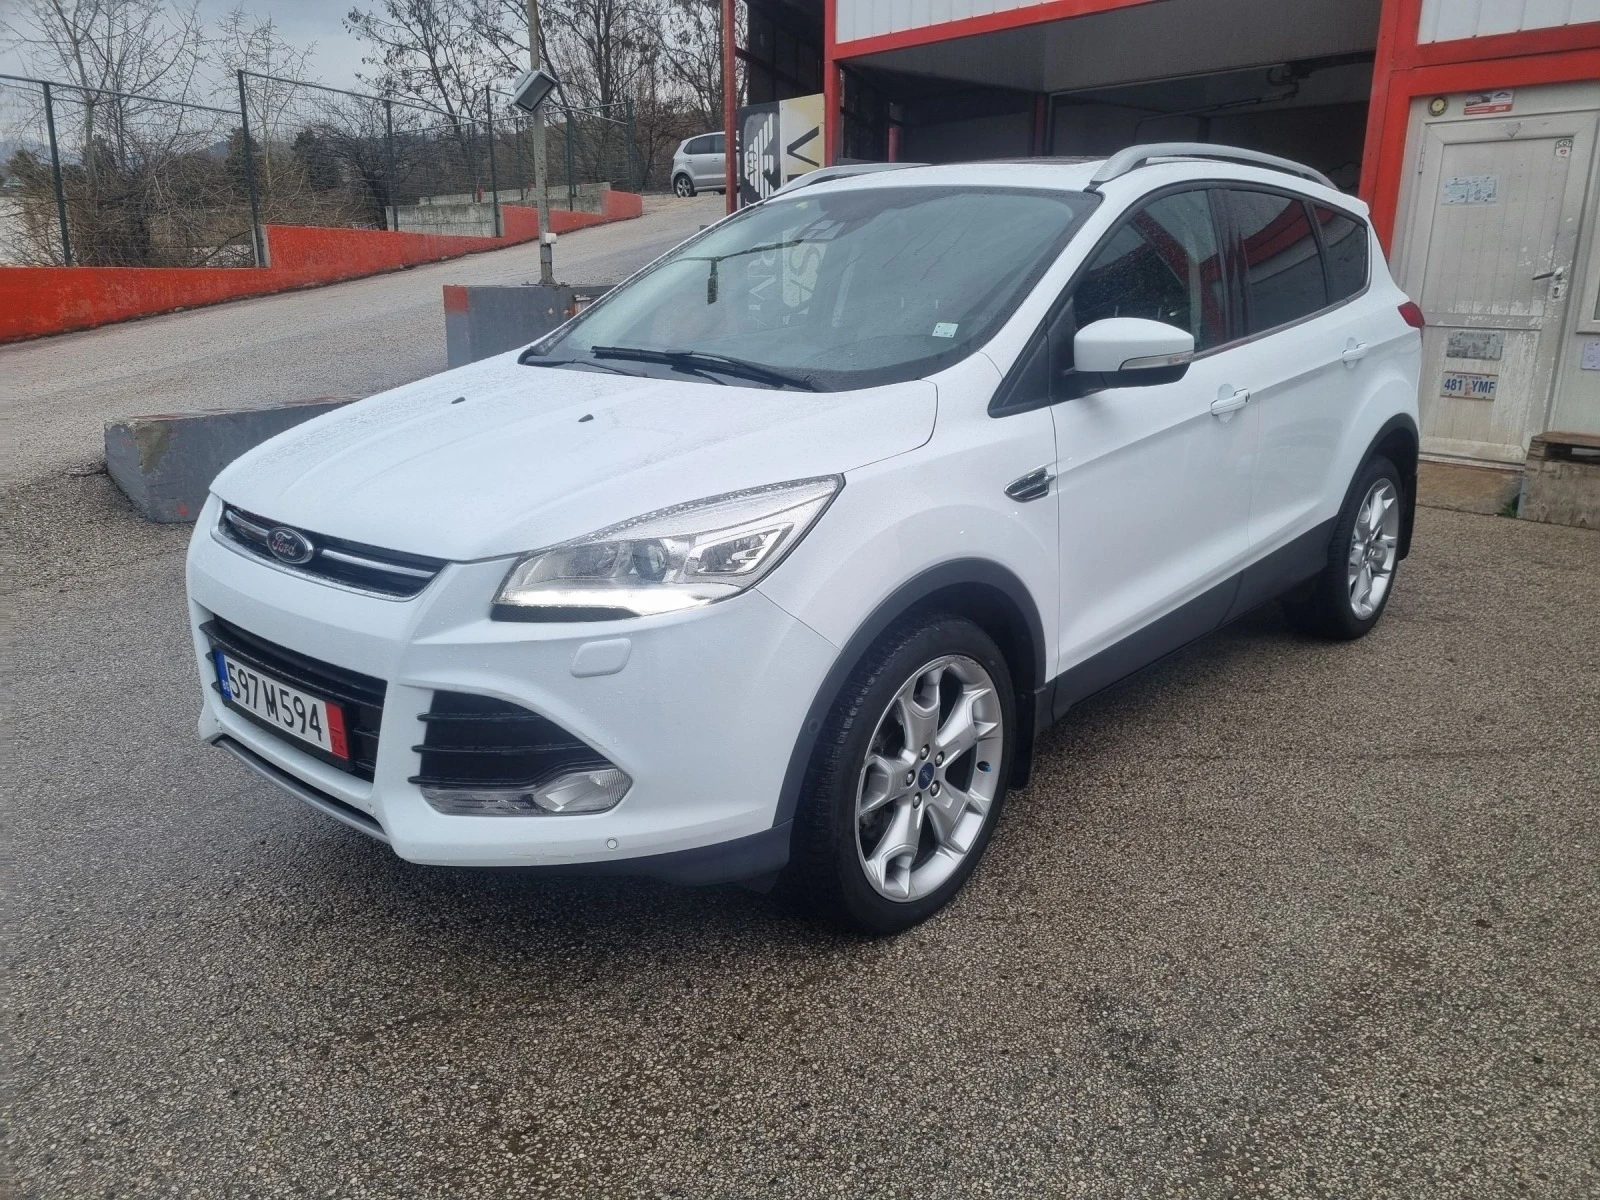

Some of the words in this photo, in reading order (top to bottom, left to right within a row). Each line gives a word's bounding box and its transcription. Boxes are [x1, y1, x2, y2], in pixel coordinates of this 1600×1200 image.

[1444, 378, 1463, 391] 481
[1471, 380, 1496, 394] YMF
[272, 531, 298, 557] Ford
